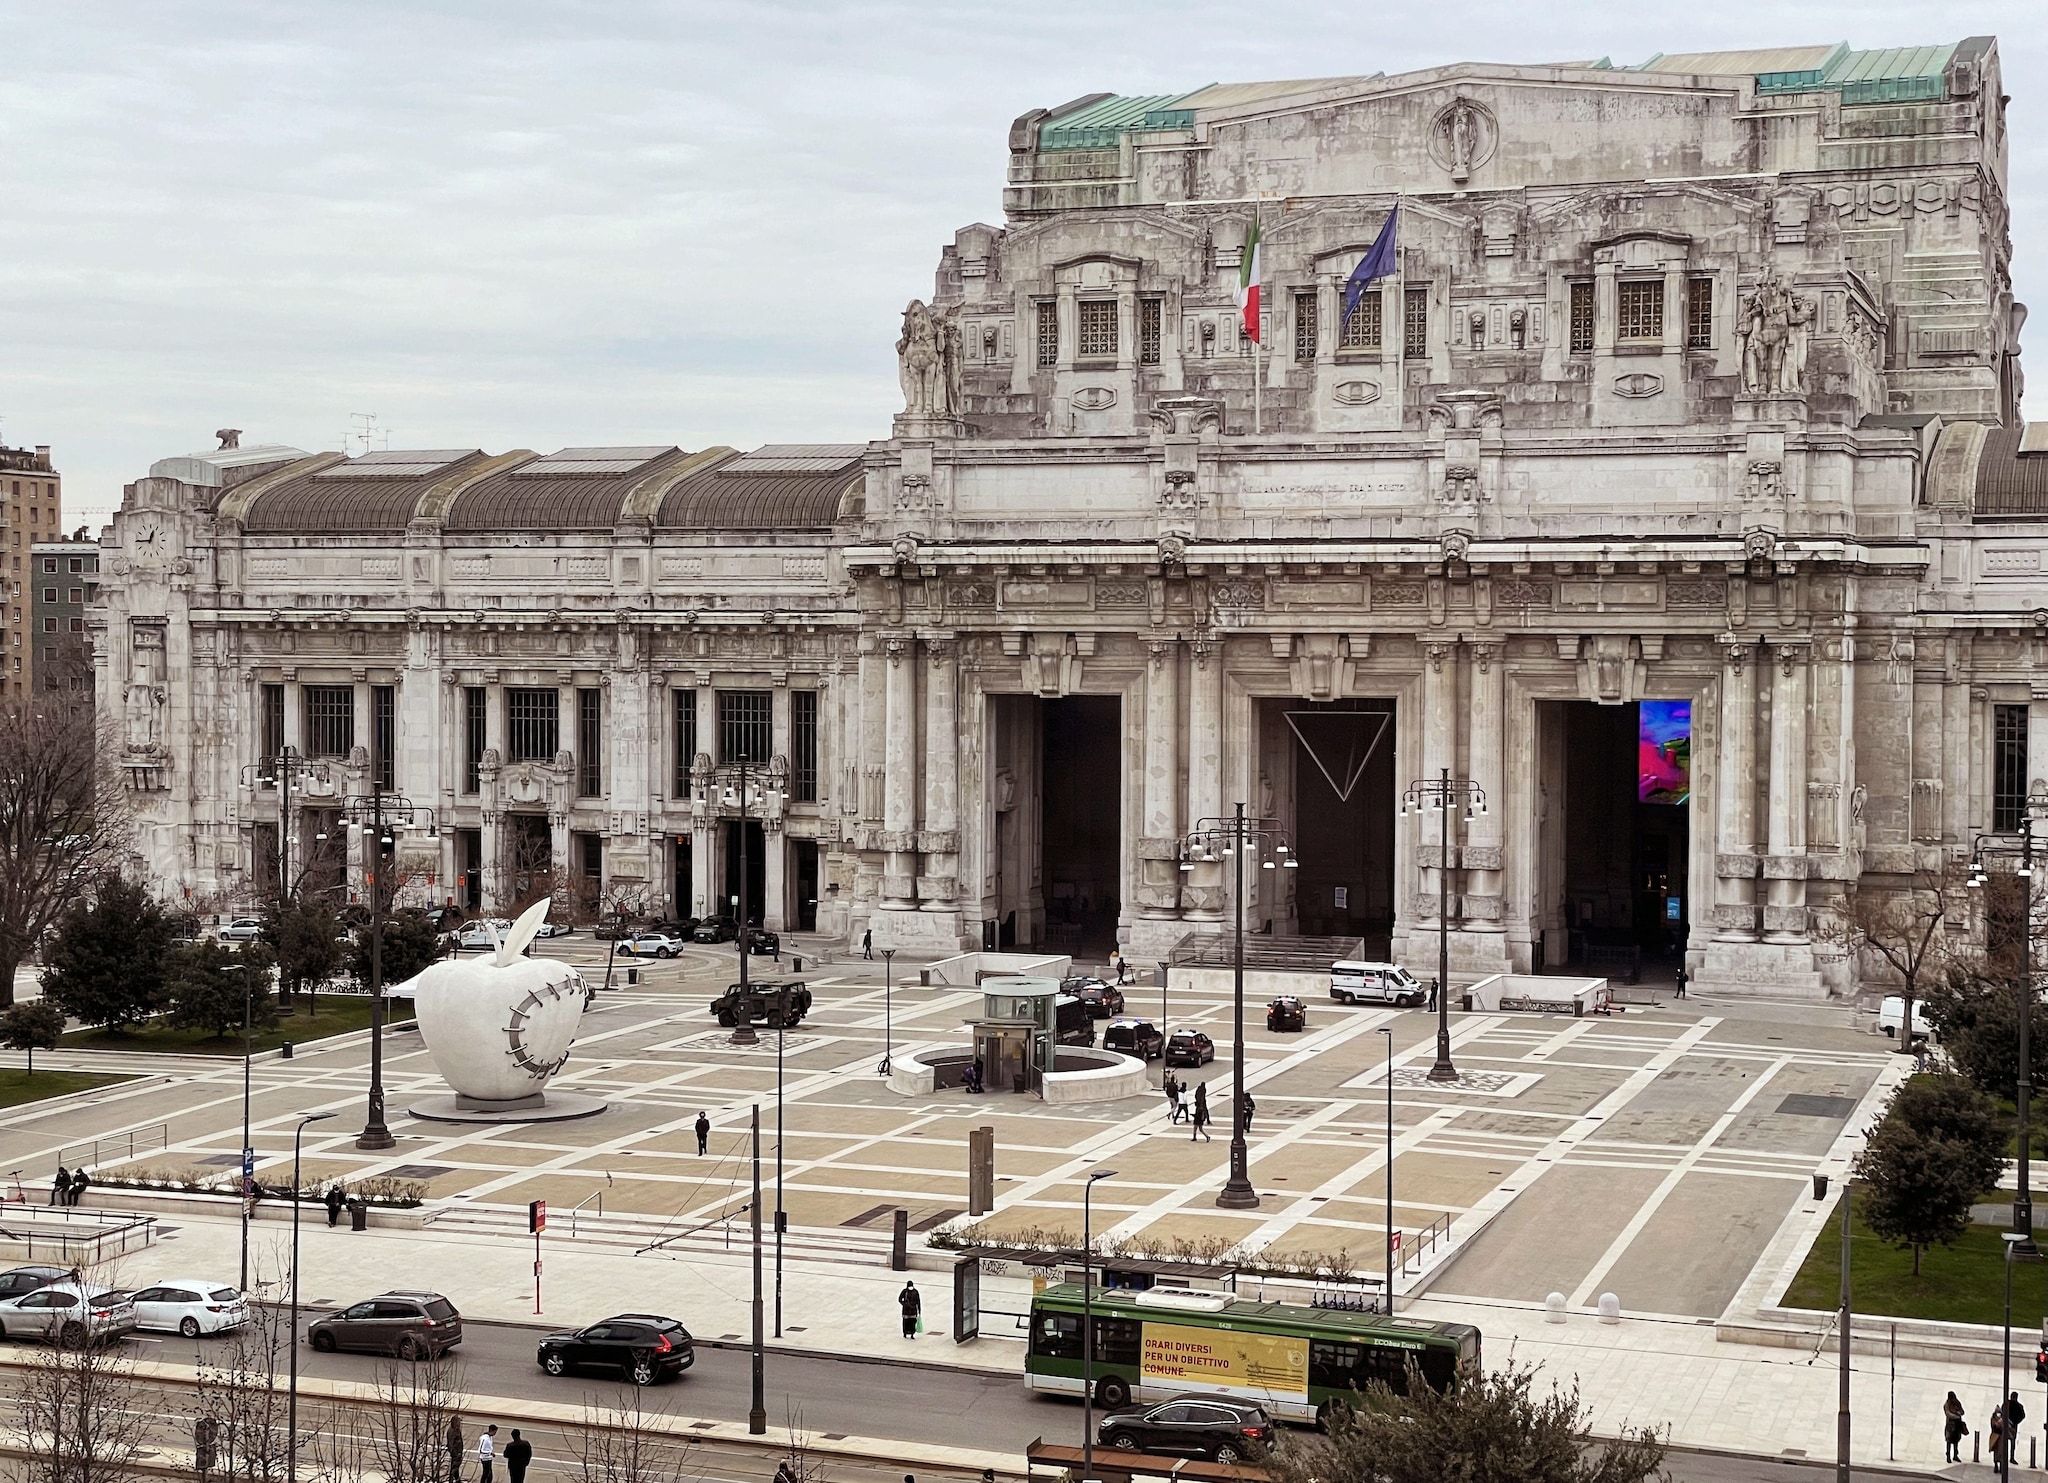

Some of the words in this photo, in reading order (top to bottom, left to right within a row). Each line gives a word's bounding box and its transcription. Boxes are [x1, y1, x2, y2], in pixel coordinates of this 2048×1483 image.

[245, 1150, 252, 1165] P
[1145, 1339, 1173, 1350] ORARI
[1175, 1342, 1212, 1354] DIVERSI
[1145, 1351, 1163, 1361] PER
[1165, 1353, 1178, 1363] UN
[1181, 1355, 1229, 1369] OBIETTIVO
[1144, 1363, 1187, 1377] COMUNE.
